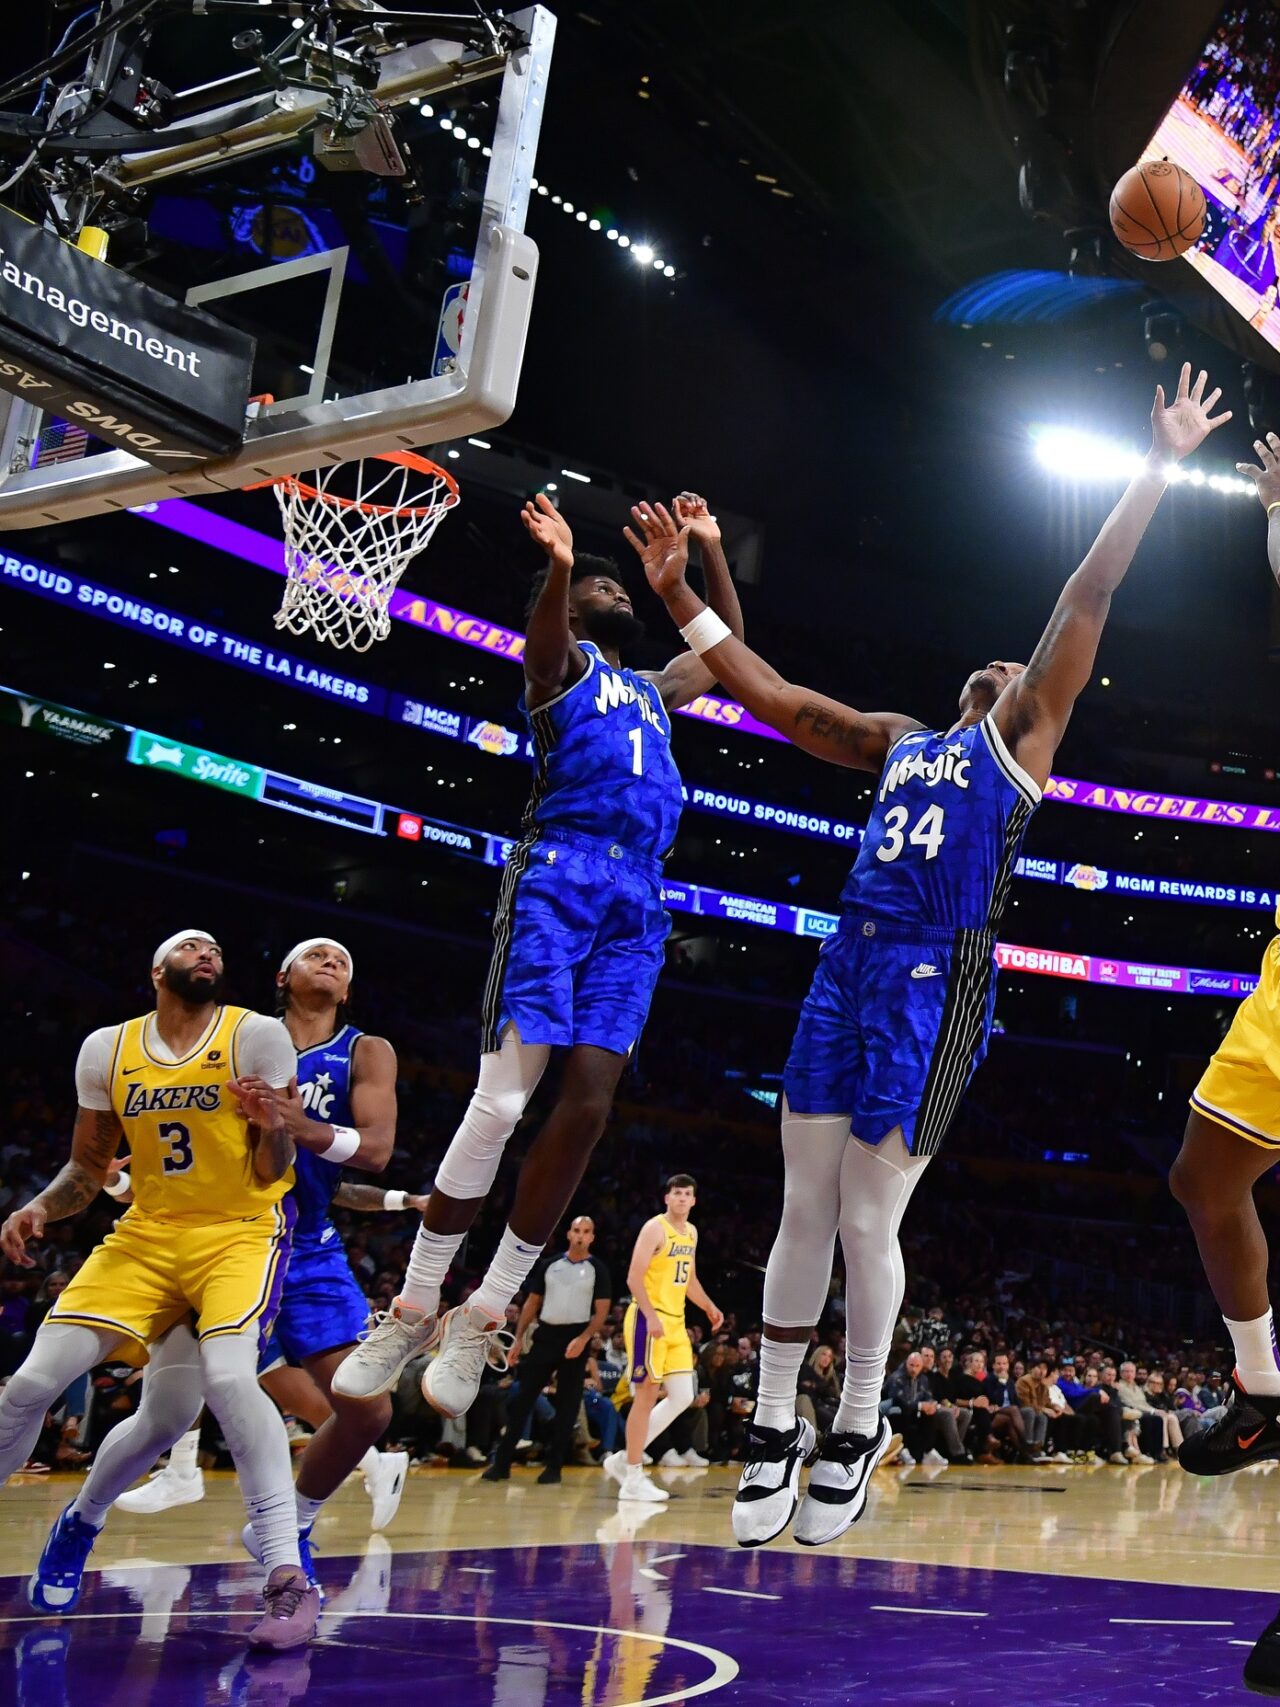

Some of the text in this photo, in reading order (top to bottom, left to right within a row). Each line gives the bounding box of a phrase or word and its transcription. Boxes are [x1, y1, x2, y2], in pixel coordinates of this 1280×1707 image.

[0, 248, 201, 378] anagement
[77, 585, 184, 637] SPONSOR
[188, 626, 218, 648] OF
[222, 636, 263, 665] THE
[265, 652, 292, 677] LA
[295, 663, 370, 704] LAKERS
[398, 600, 526, 660] ANGEL
[424, 706, 461, 729] MGM
[628, 727, 644, 776] 1
[192, 755, 251, 788] Sprite
[693, 789, 751, 815] PROUD
[754, 804, 830, 835] SPONSOR
[833, 823, 855, 840] OF
[1082, 787, 1247, 825] ANGELES
[423, 825, 472, 850] TOYOTA
[876, 803, 946, 862] 34
[1025, 858, 1057, 874] MGM
[719, 895, 777, 915] AMERICAN
[1116, 875, 1155, 893] MGM
[1160, 880, 1236, 902] REWARDS
[1241, 890, 1256, 904] IS
[1260, 892, 1271, 906] A
[726, 906, 776, 926] EXPRESS
[807, 917, 838, 934] UCLA
[999, 948, 1086, 977] TOSHIBA
[122, 1082, 221, 1118] LAKERS
[158, 1121, 194, 1175] 3
[674, 1260, 690, 1285] 15
